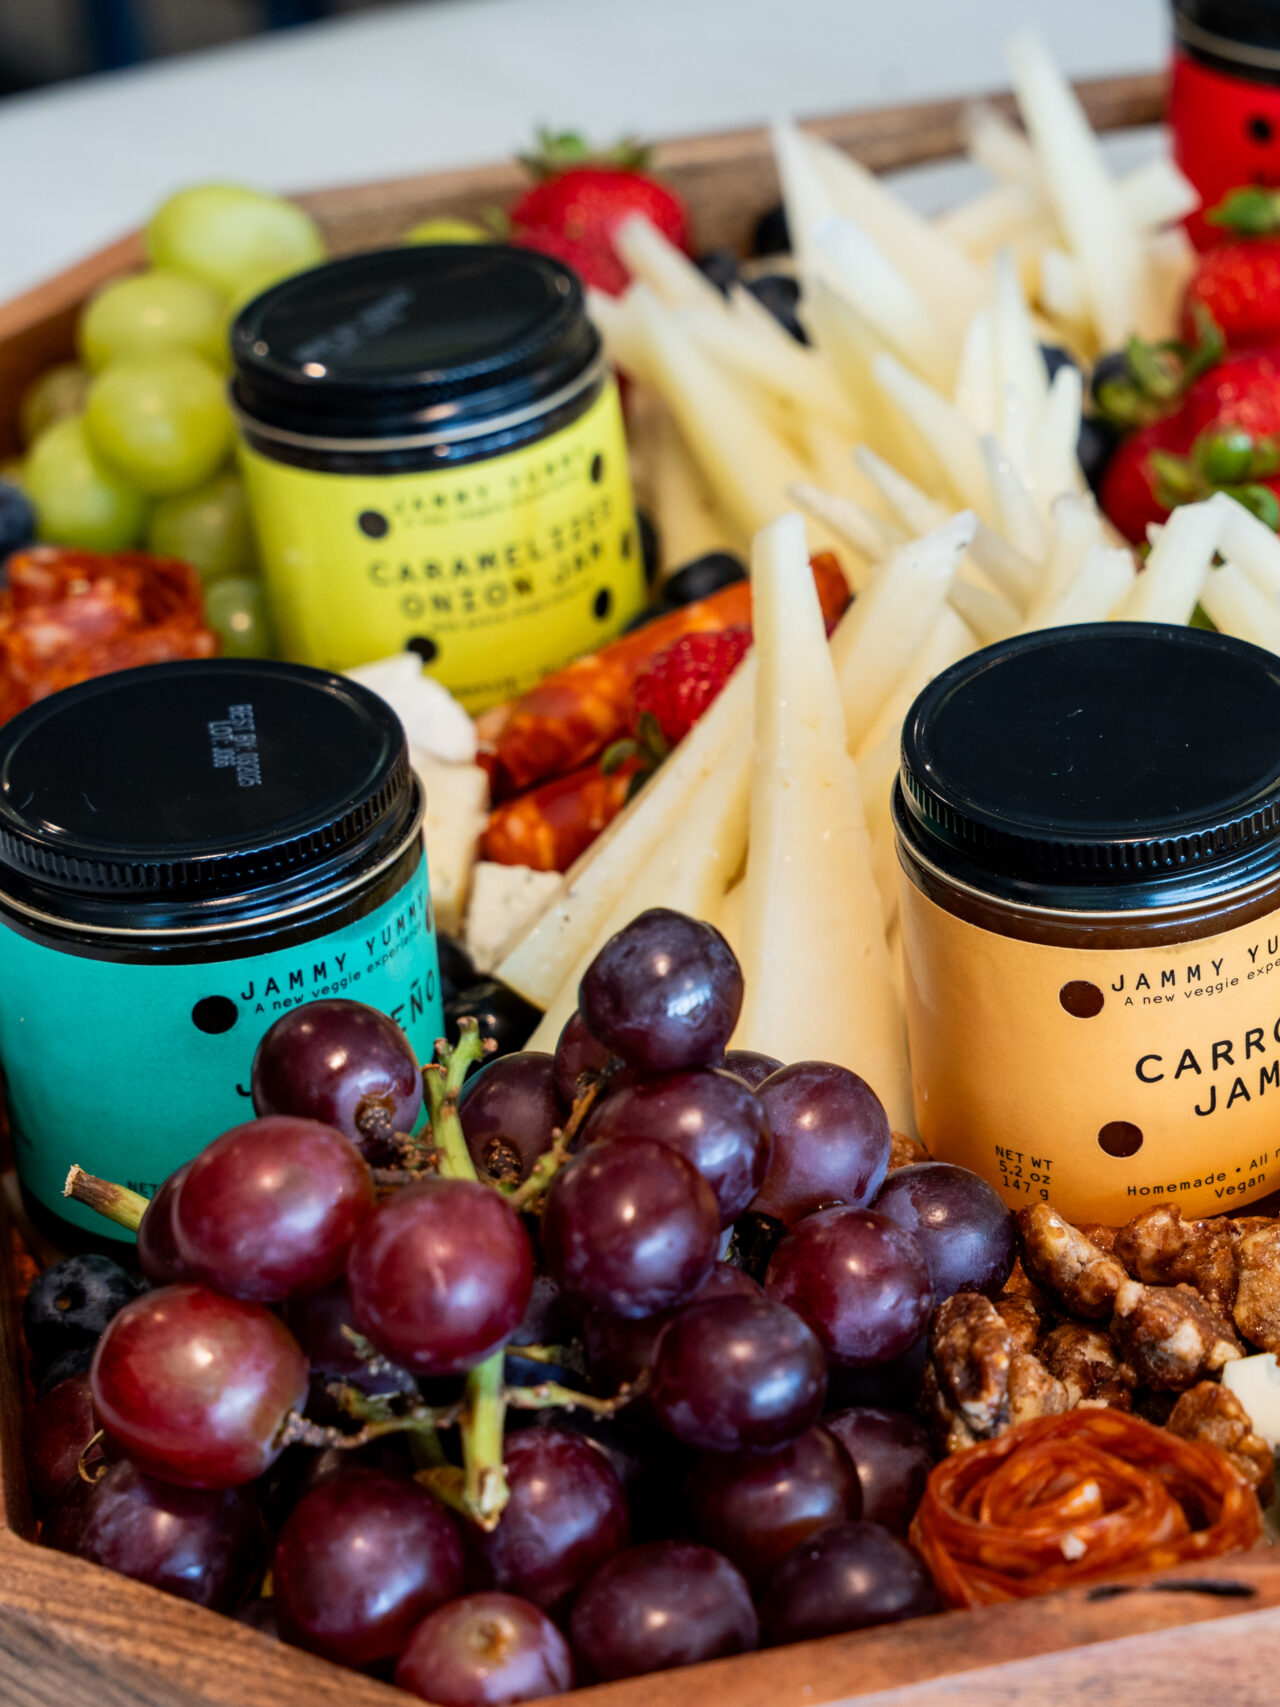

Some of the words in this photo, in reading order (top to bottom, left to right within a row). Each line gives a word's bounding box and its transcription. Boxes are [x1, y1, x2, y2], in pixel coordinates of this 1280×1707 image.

[401, 577, 533, 619] ONION
[241, 953, 346, 1000] JAMMY
[366, 889, 424, 956] YUMMY
[1111, 957, 1224, 992] JAMMY
[255, 1002, 265, 1014] A
[273, 995, 304, 1011] new
[312, 970, 361, 999] veggie
[1124, 995, 1134, 1006] A
[1142, 991, 1175, 1006] new
[1184, 976, 1240, 1000] veggie
[995, 1145, 1024, 1163] NET
[1031, 1156, 1053, 1171] WT
[999, 1160, 1026, 1178] 5.2
[1030, 1172, 1051, 1186] oz
[1002, 1175, 1031, 1193] 147
[1039, 1188, 1049, 1201] g
[1127, 1170, 1227, 1197] Homemade
[1249, 1153, 1268, 1171] All
[1215, 1173, 1267, 1200] Vegan
